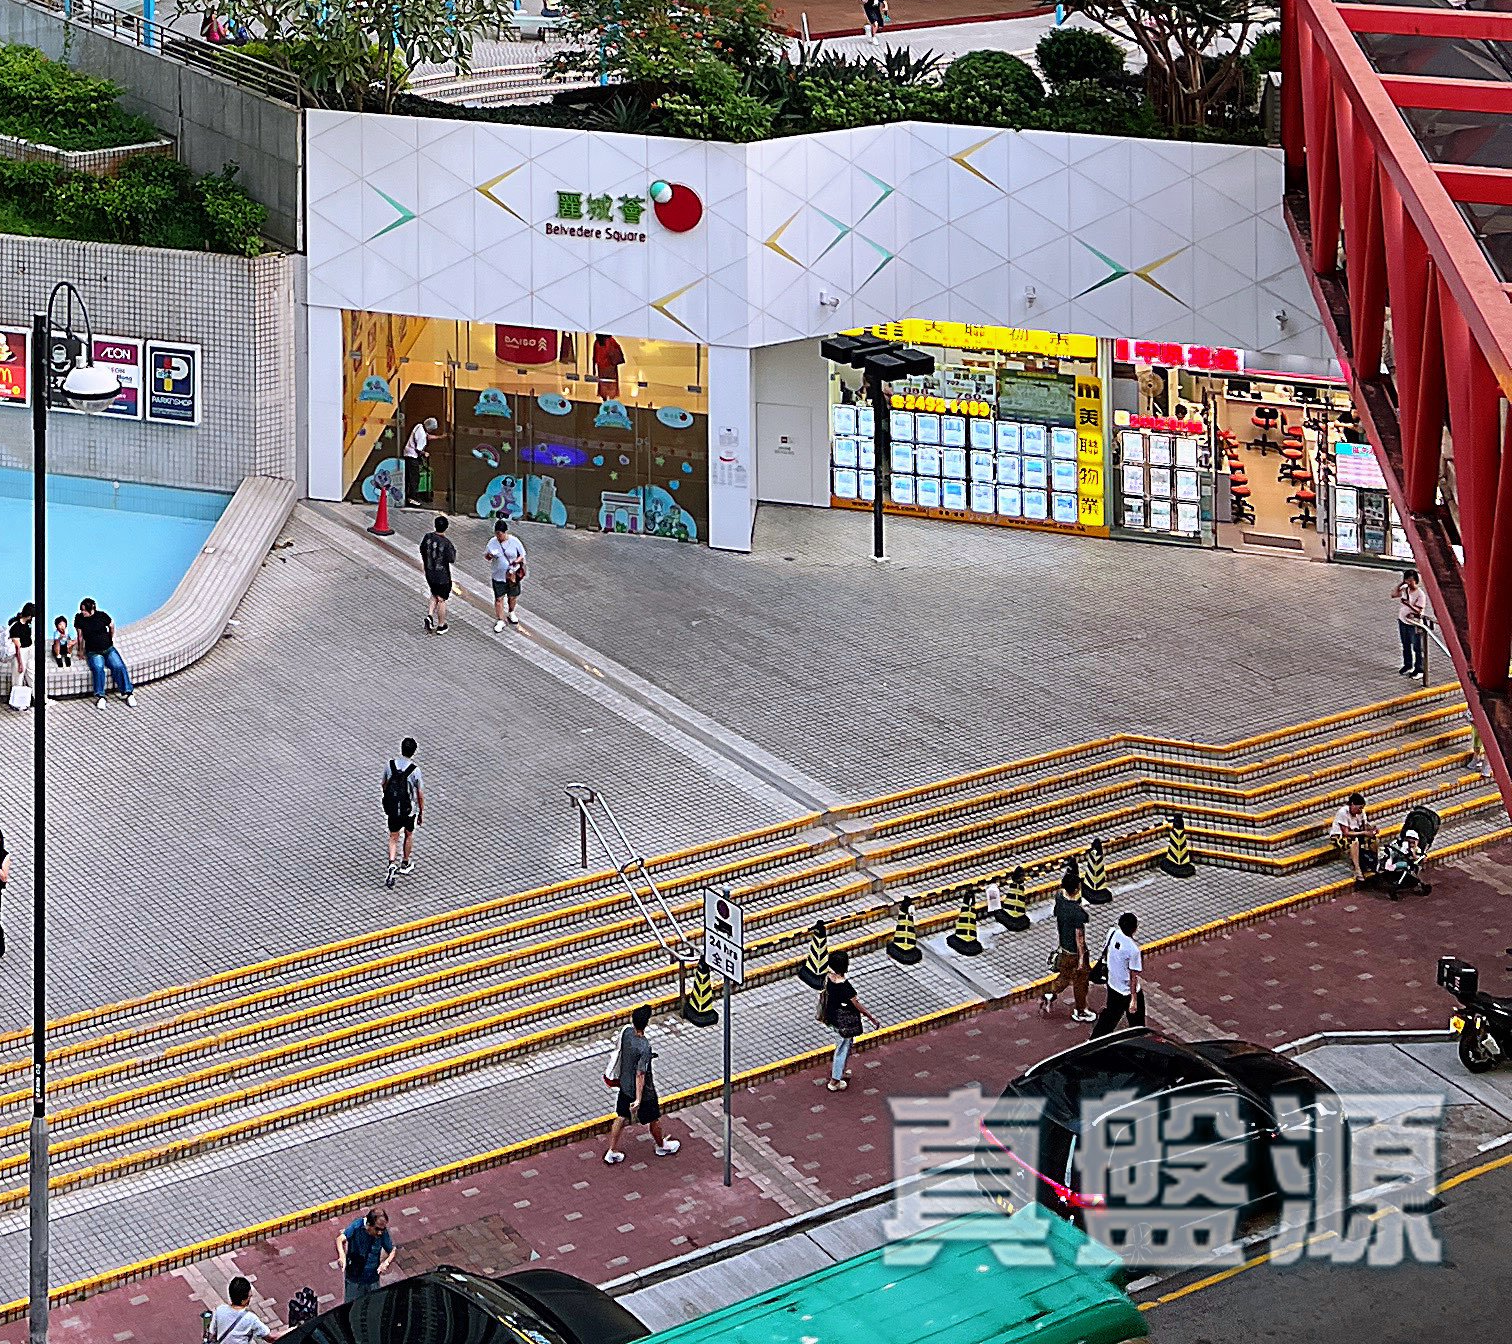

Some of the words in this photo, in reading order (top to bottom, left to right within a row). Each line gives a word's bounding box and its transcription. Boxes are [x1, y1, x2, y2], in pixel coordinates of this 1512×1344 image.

[545, 222, 602, 240] Belvedere
[605, 227, 646, 243] Square
[504, 335, 537, 347] DAISO
[1079, 407, 1100, 515] 美聯物業
[709, 934, 722, 950] 24
[712, 951, 735, 976] 全日
